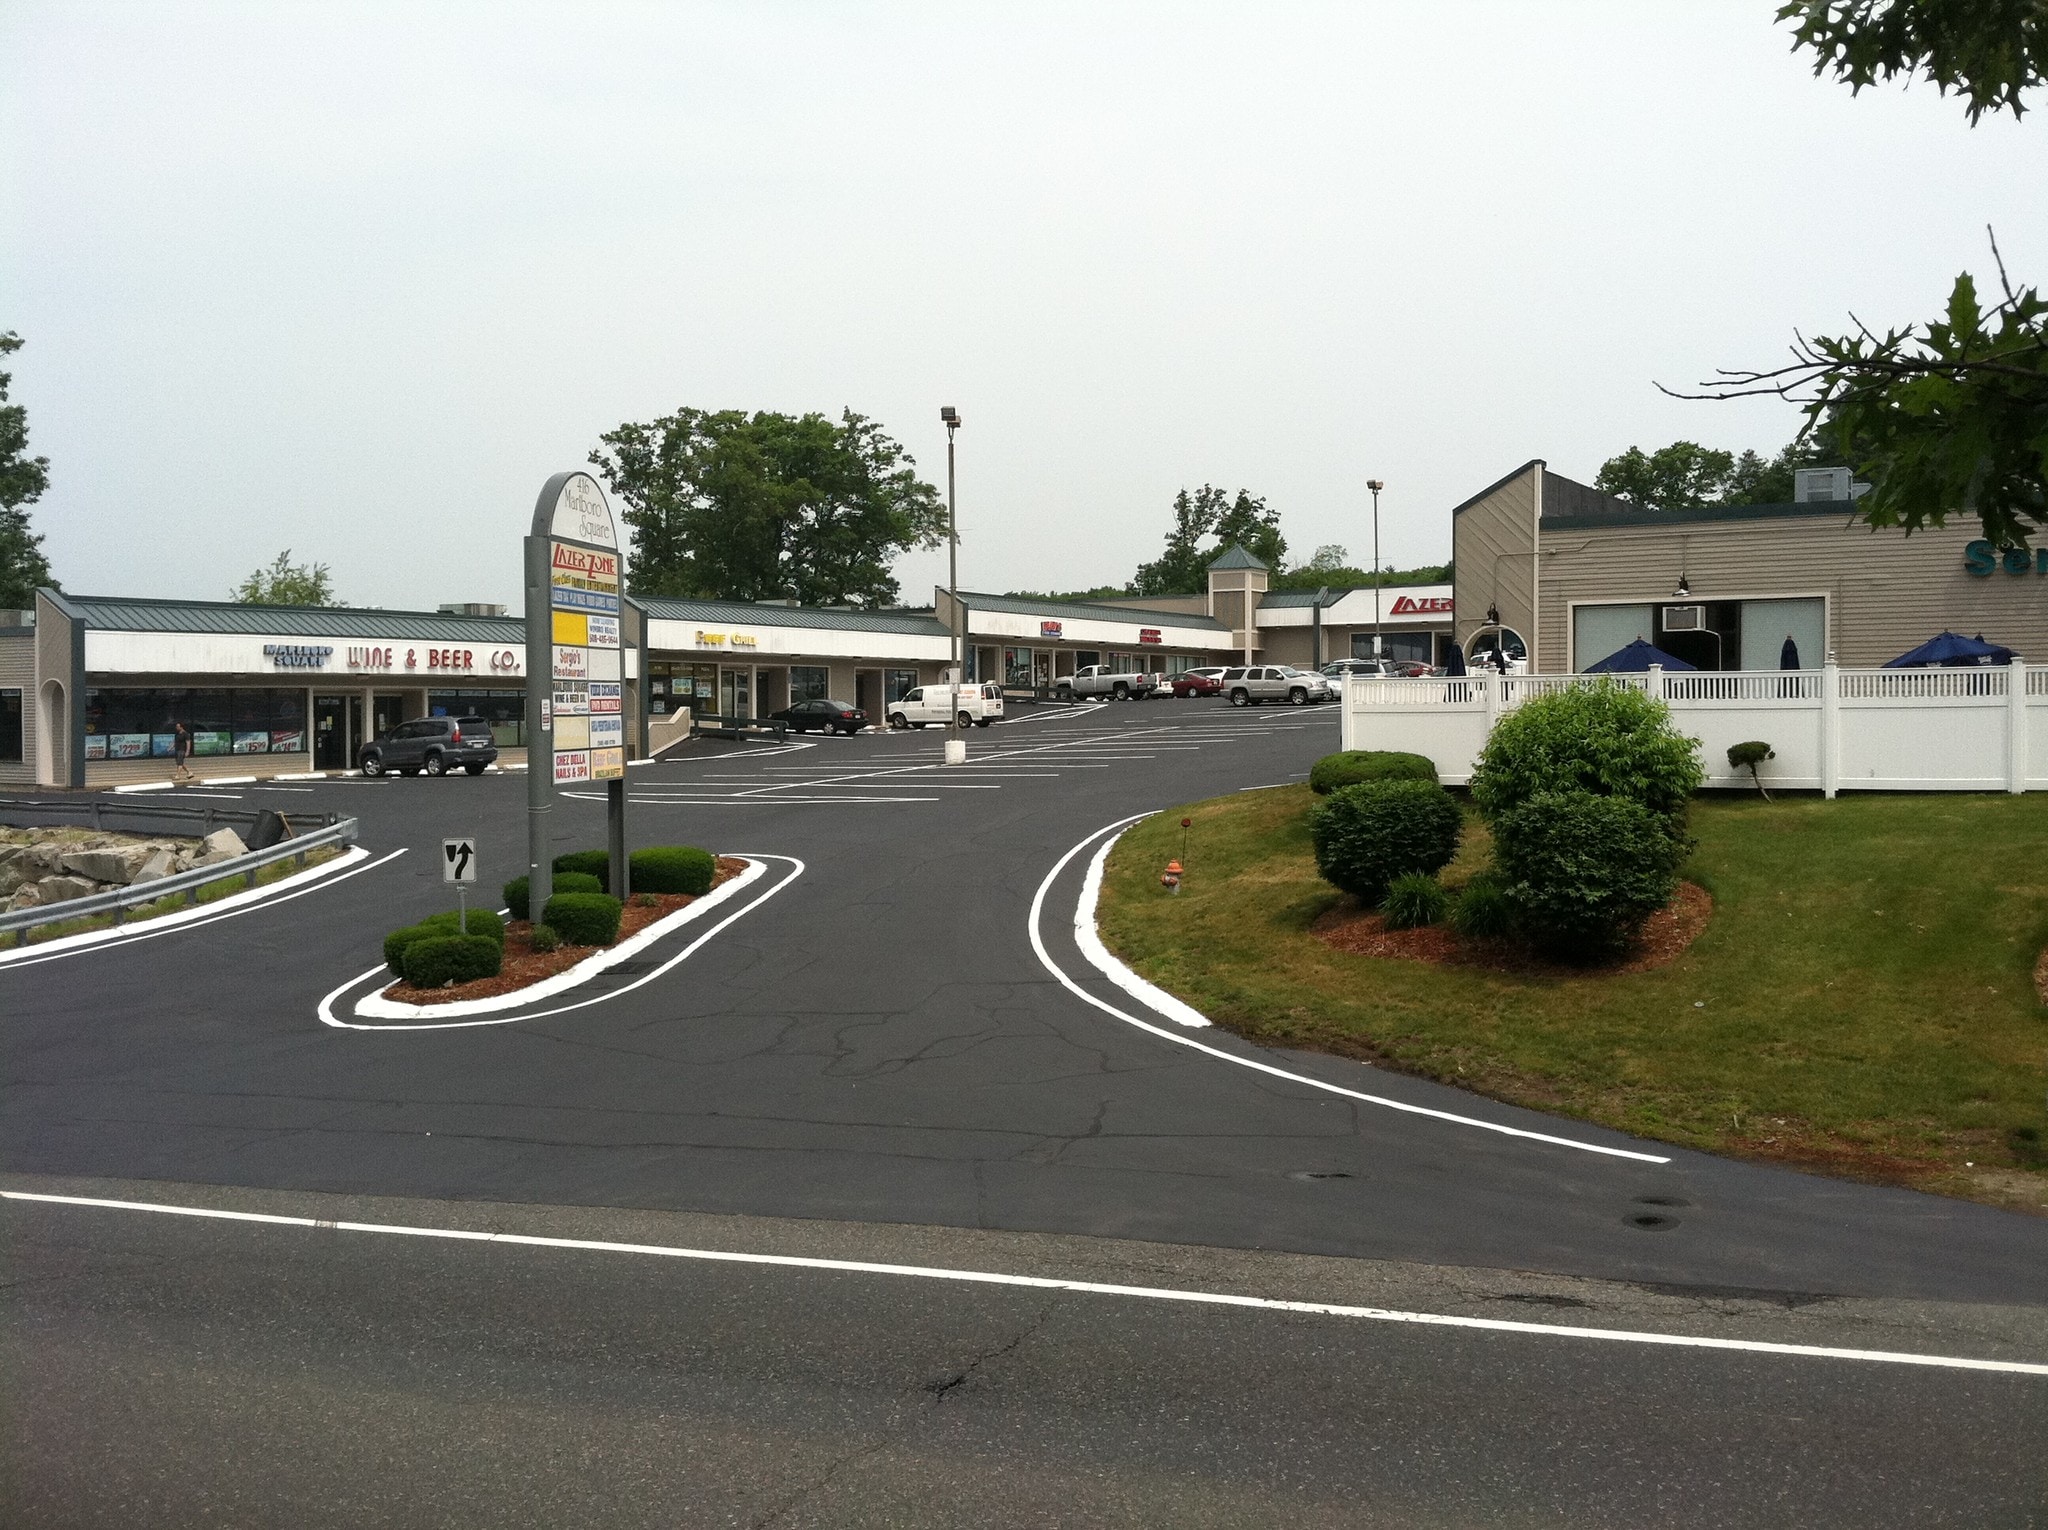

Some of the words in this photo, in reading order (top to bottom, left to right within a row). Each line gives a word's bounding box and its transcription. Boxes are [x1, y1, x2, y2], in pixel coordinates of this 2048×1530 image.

[564, 487, 602, 518] Marlboro
[579, 514, 610, 542] Square
[552, 543, 586, 570] LAZER
[587, 554, 616, 580] ZONE
[1390, 596, 1455, 615] LAZER
[263, 644, 334, 656] MARLBORO
[274, 655, 326, 668] SQUARE
[405, 648, 417, 668] &
[428, 648, 473, 668] BEER
[490, 650, 521, 671] CO.
[553, 665, 586, 678] Restaurant
[555, 754, 570, 766] CHEZ
[555, 767, 571, 779] NAILS
[576, 766, 588, 777] SPA
